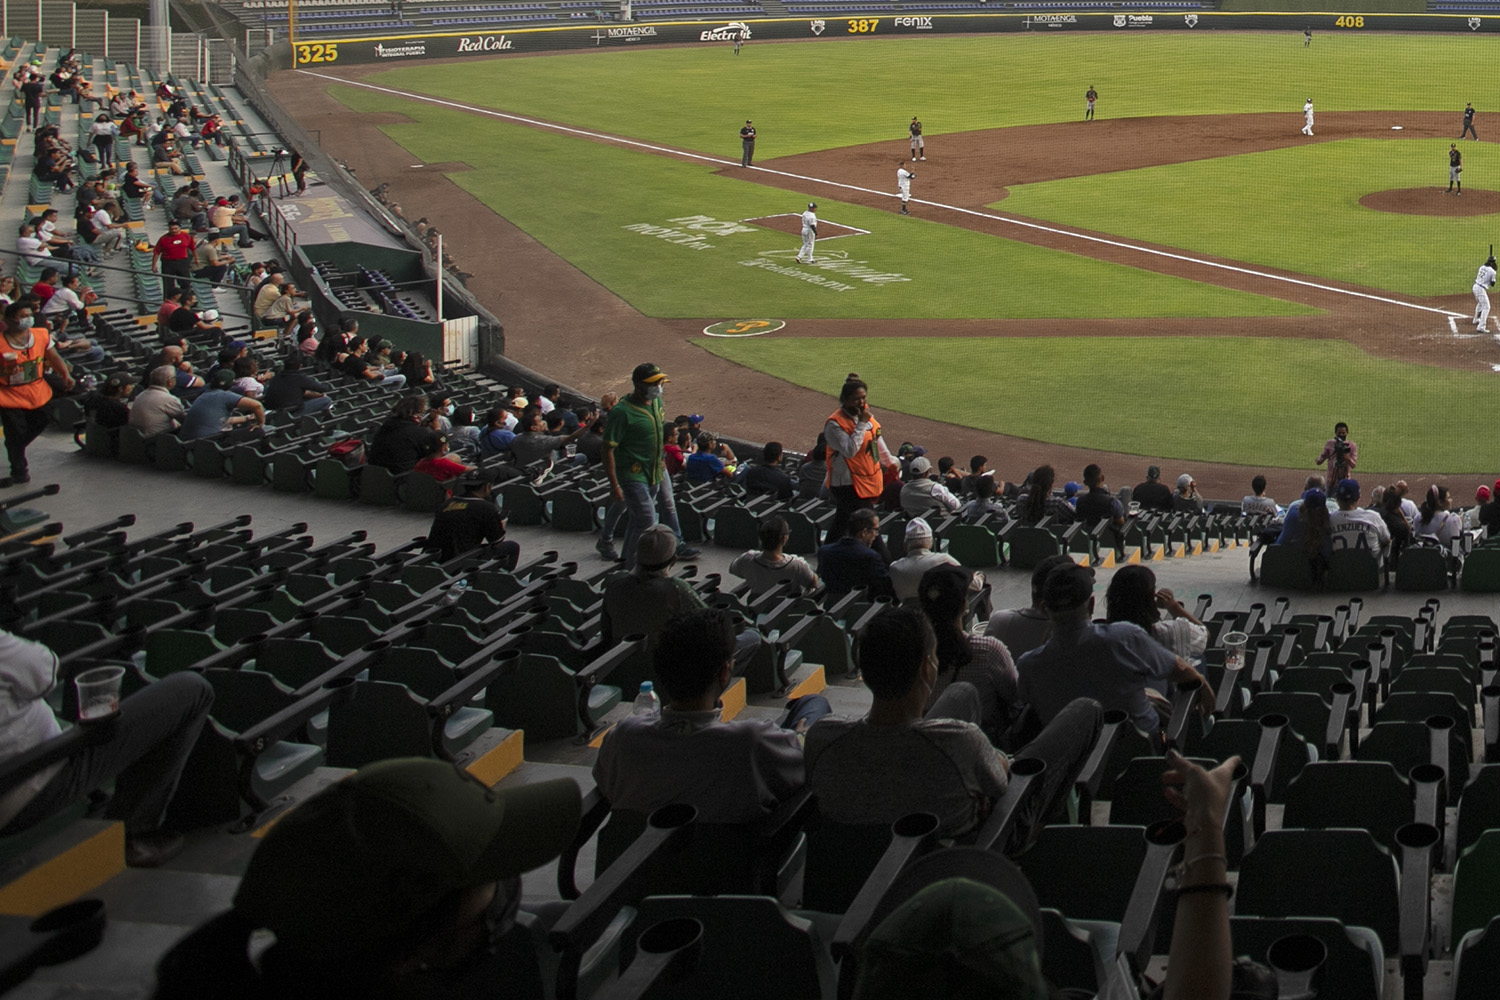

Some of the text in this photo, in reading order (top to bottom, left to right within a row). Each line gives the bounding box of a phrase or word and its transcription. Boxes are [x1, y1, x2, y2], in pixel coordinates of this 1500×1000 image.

[848, 19, 880, 33] 387
[1335, 16, 1364, 28] 408
[298, 44, 338, 64] 325
